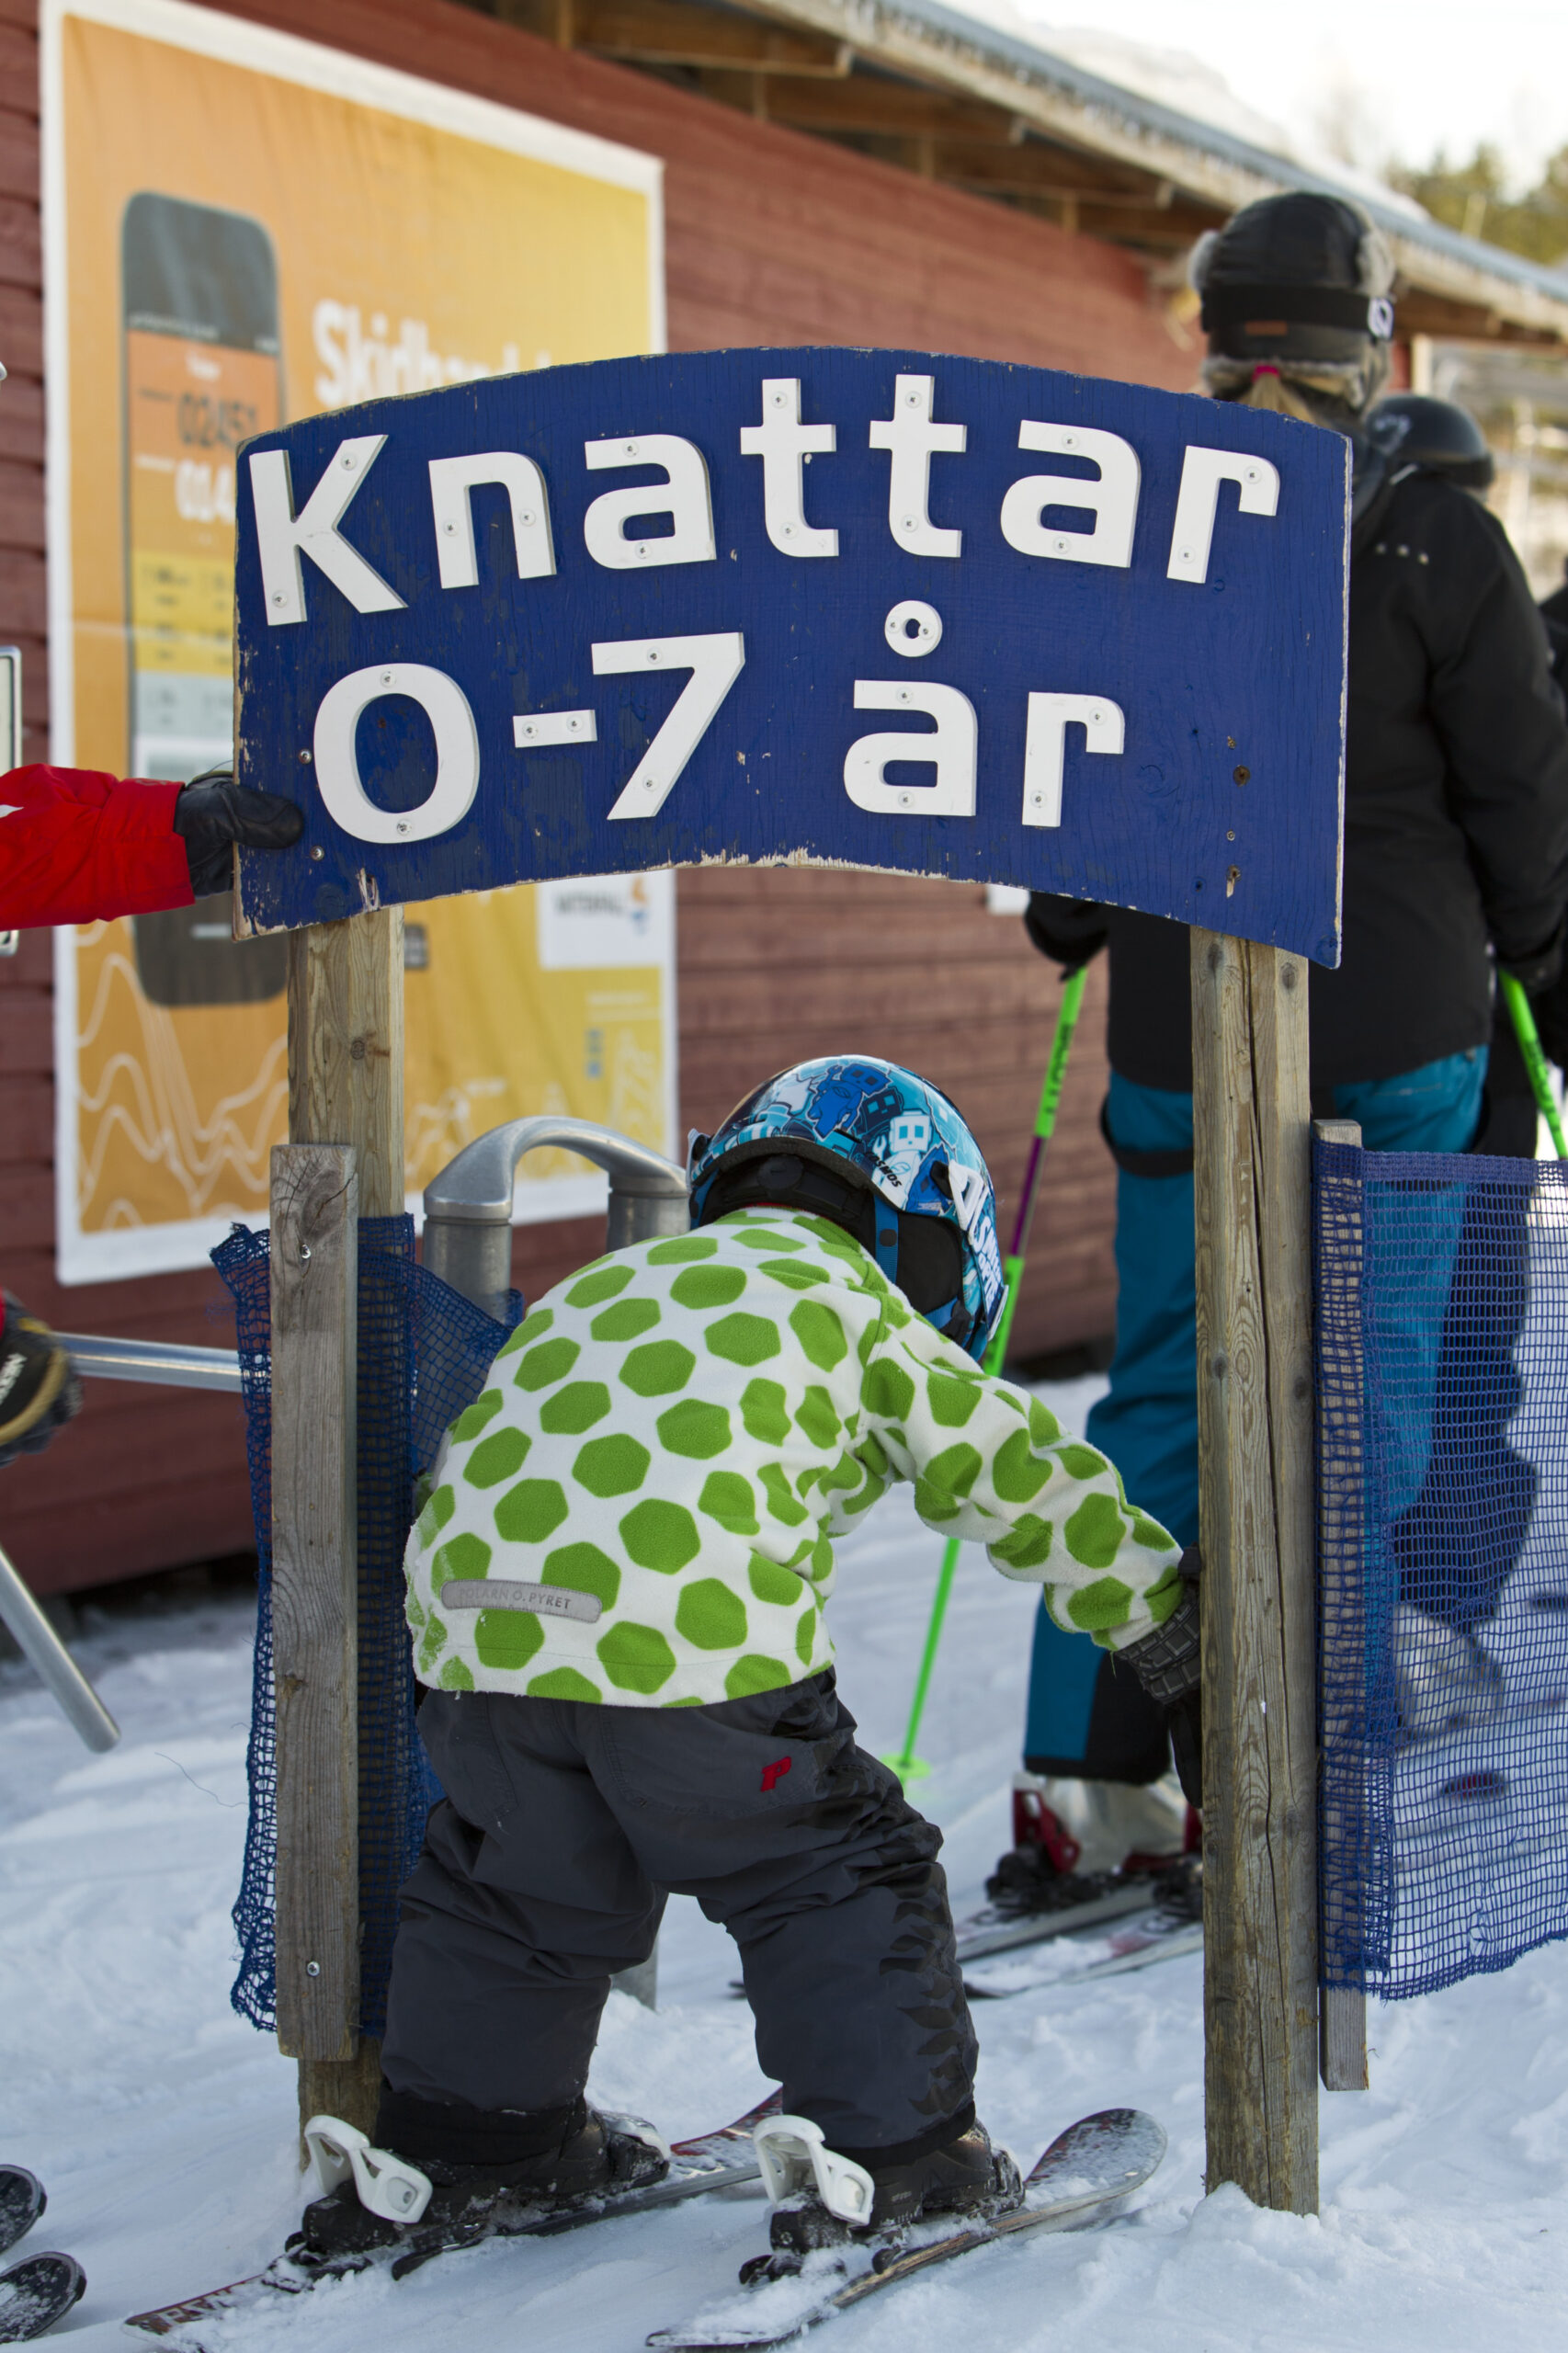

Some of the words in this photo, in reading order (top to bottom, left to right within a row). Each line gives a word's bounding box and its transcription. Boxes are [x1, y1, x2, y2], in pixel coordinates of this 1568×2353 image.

[249, 374, 1280, 626] Knattar
[313, 631, 745, 844] 0-7
[844, 600, 1125, 827] år
[460, 1586, 509, 1601] POLARN
[529, 1592, 571, 1609] PYRET
